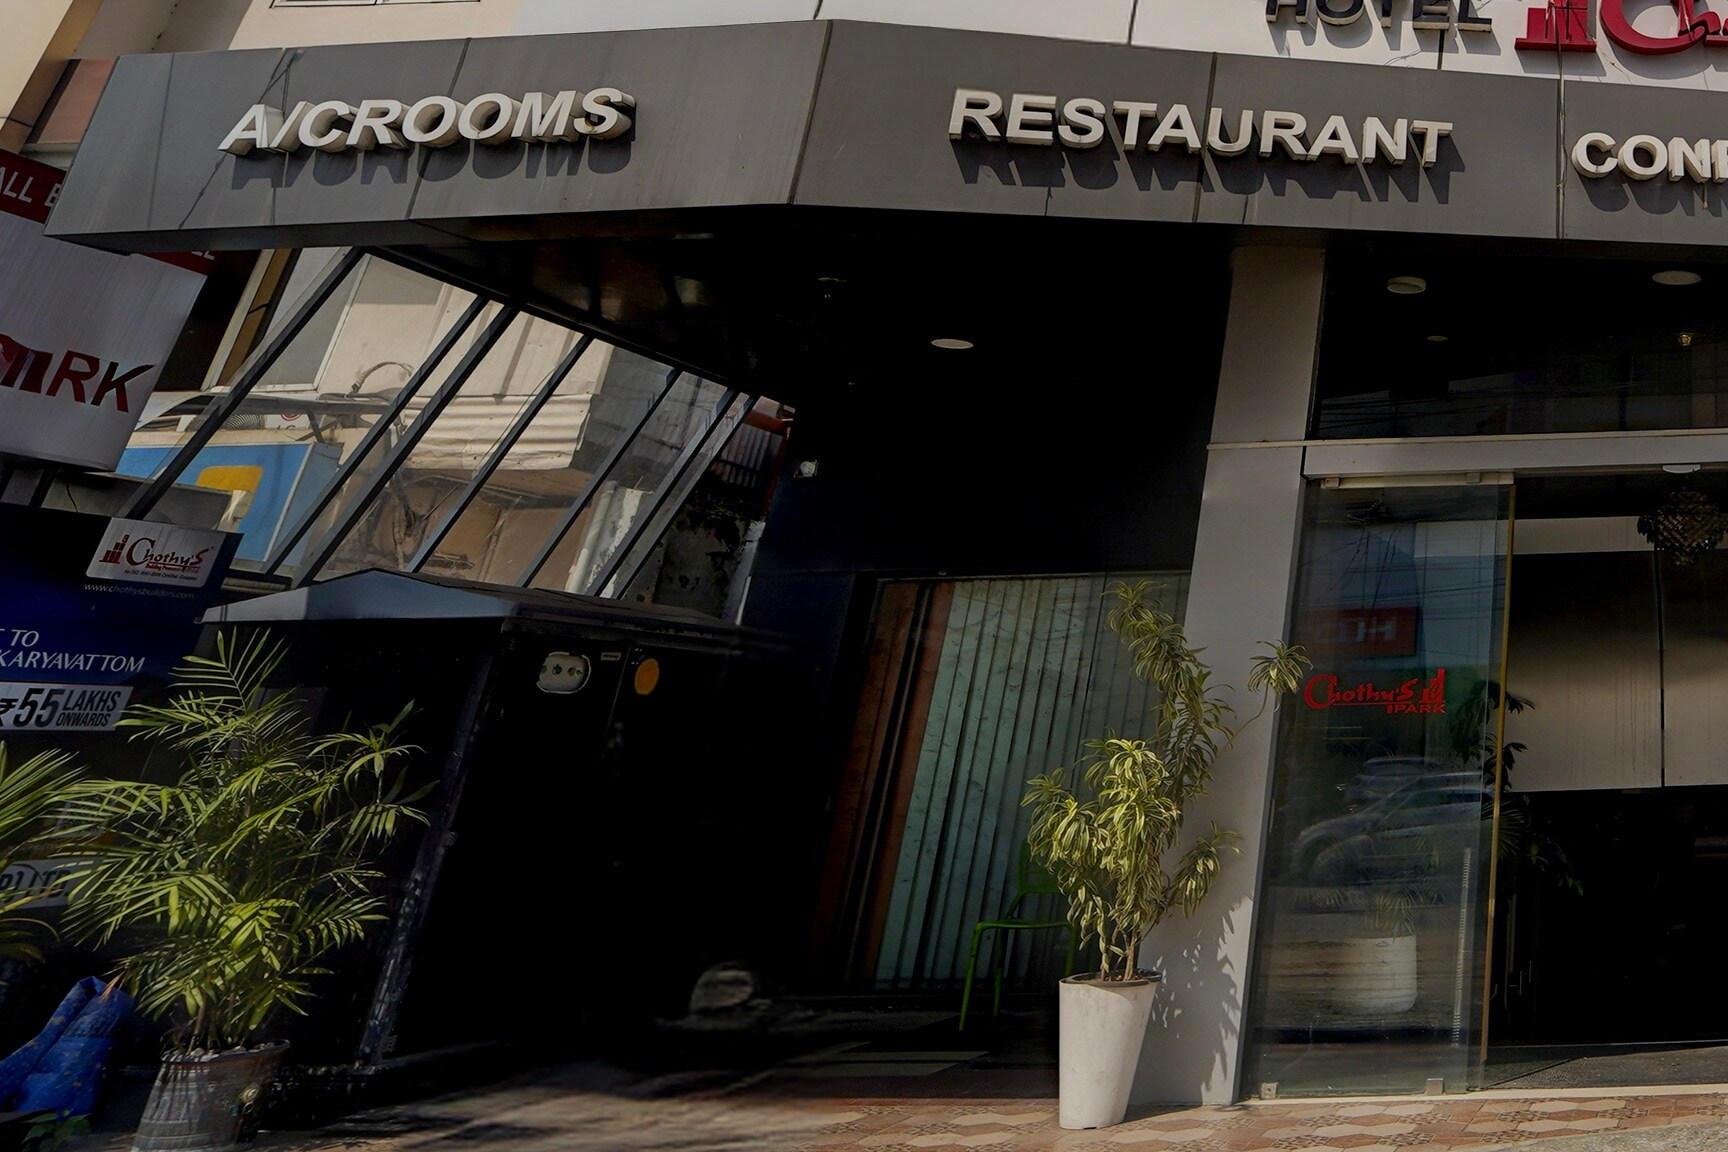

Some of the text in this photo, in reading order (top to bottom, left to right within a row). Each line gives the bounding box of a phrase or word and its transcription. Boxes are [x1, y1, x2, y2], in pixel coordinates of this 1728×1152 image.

[948, 88, 1453, 168] RESTAURANT
[10, 629, 41, 648] TO
[63, 689, 122, 712] LAKHS
[1394, 703, 1447, 714] PARK
[56, 711, 111, 728] ONWARDS
